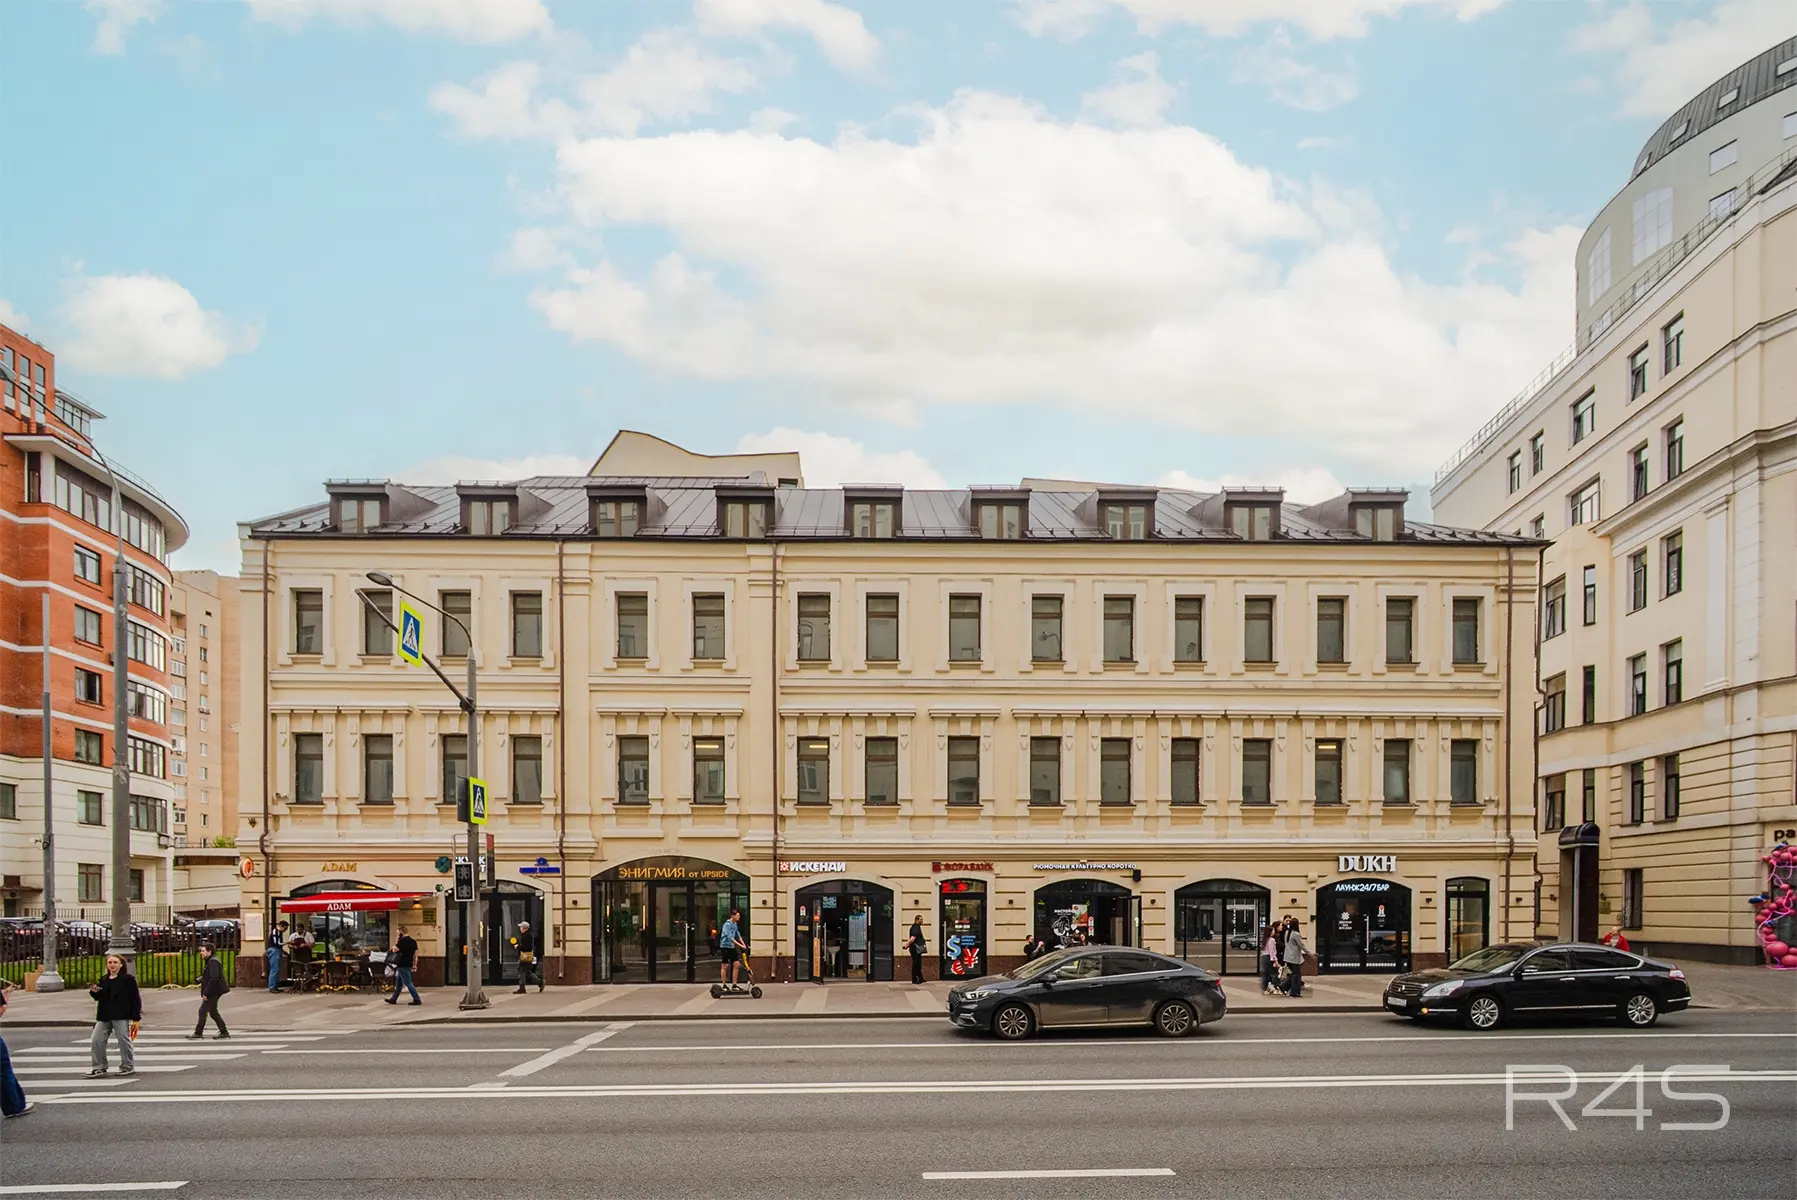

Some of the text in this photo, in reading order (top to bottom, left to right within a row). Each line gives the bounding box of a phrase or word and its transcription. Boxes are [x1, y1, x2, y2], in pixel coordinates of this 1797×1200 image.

[321, 862, 358, 872] ADAM
[1338, 855, 1397, 872] DUKH
[618, 867, 685, 878] ЭНИГМИЯ
[700, 870, 729, 878] UPSIDE
[327, 903, 352, 911] ADAM
